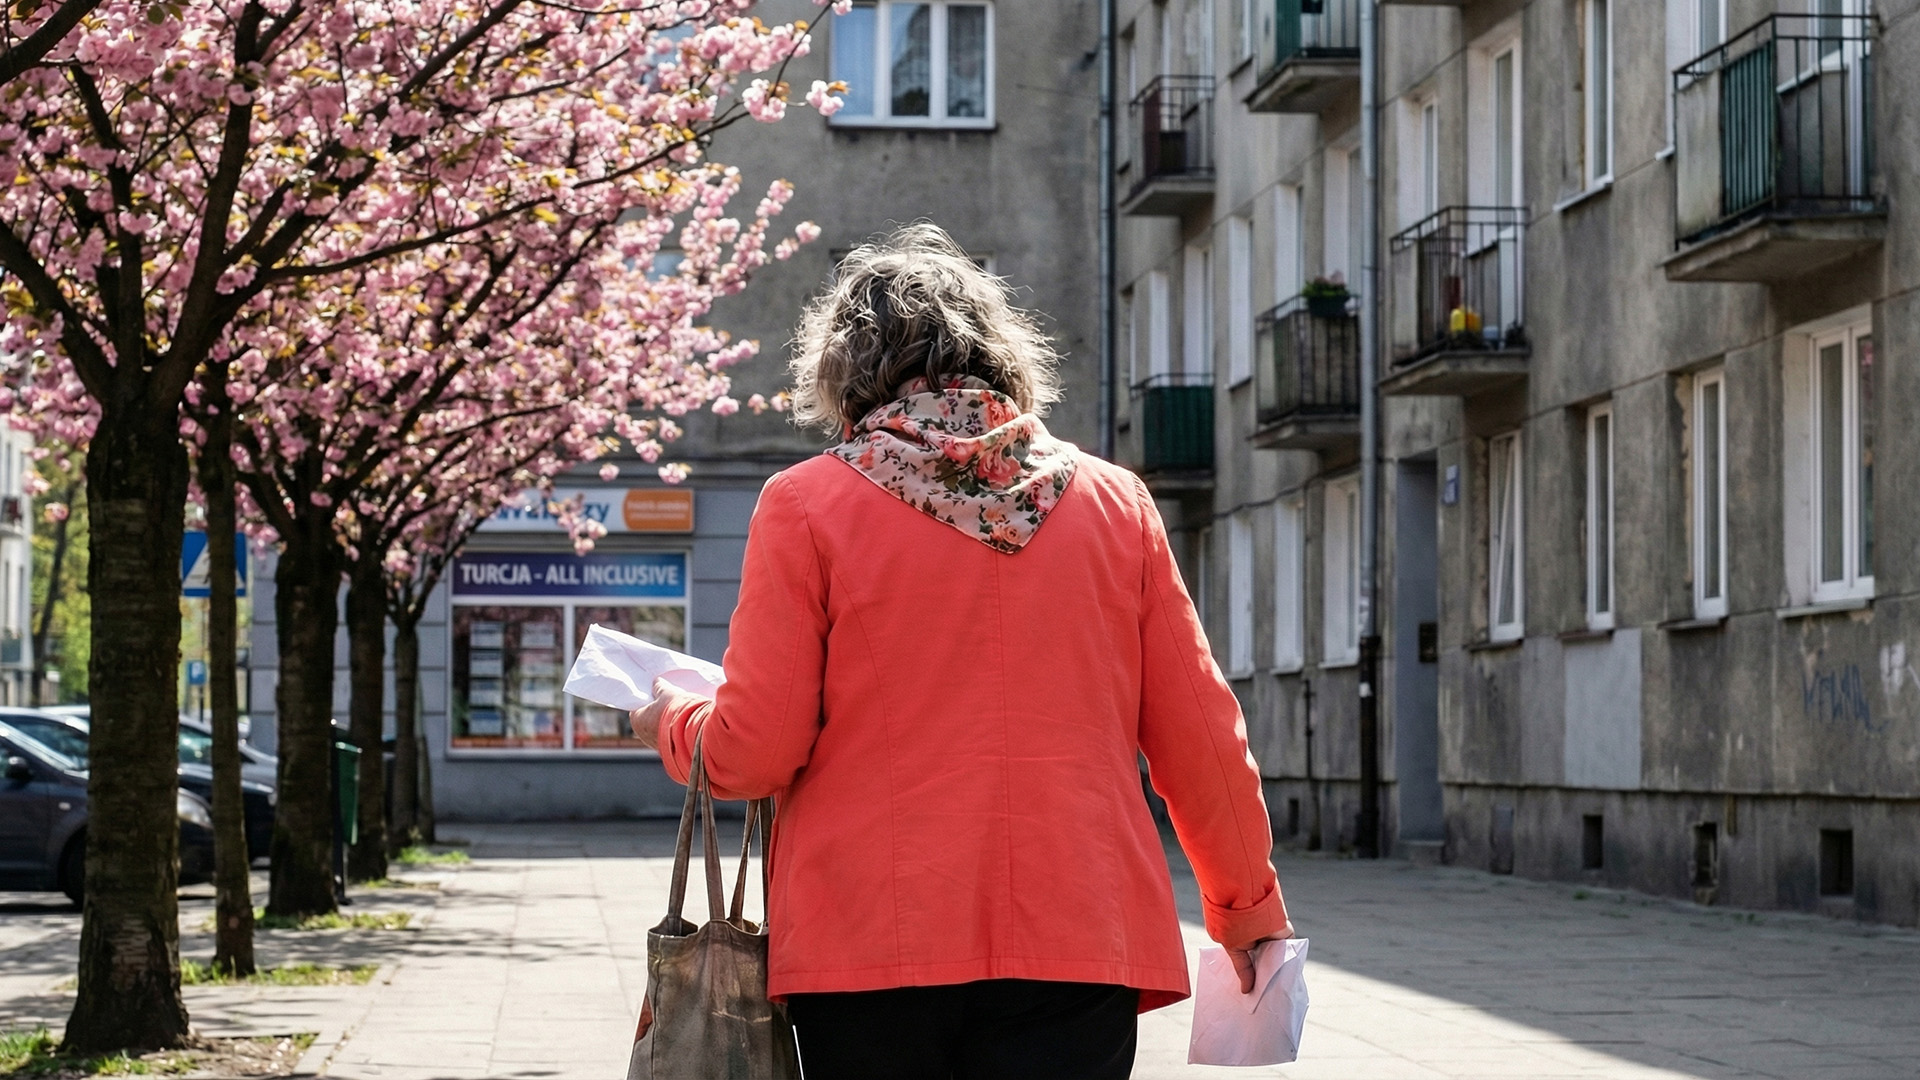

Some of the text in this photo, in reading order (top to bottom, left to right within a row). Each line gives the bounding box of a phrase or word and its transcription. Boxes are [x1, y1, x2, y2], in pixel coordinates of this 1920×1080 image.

[460, 564, 532, 585] TURCJA
[545, 565, 580, 585] ALL
[583, 565, 679, 586] INCLUSIVE
